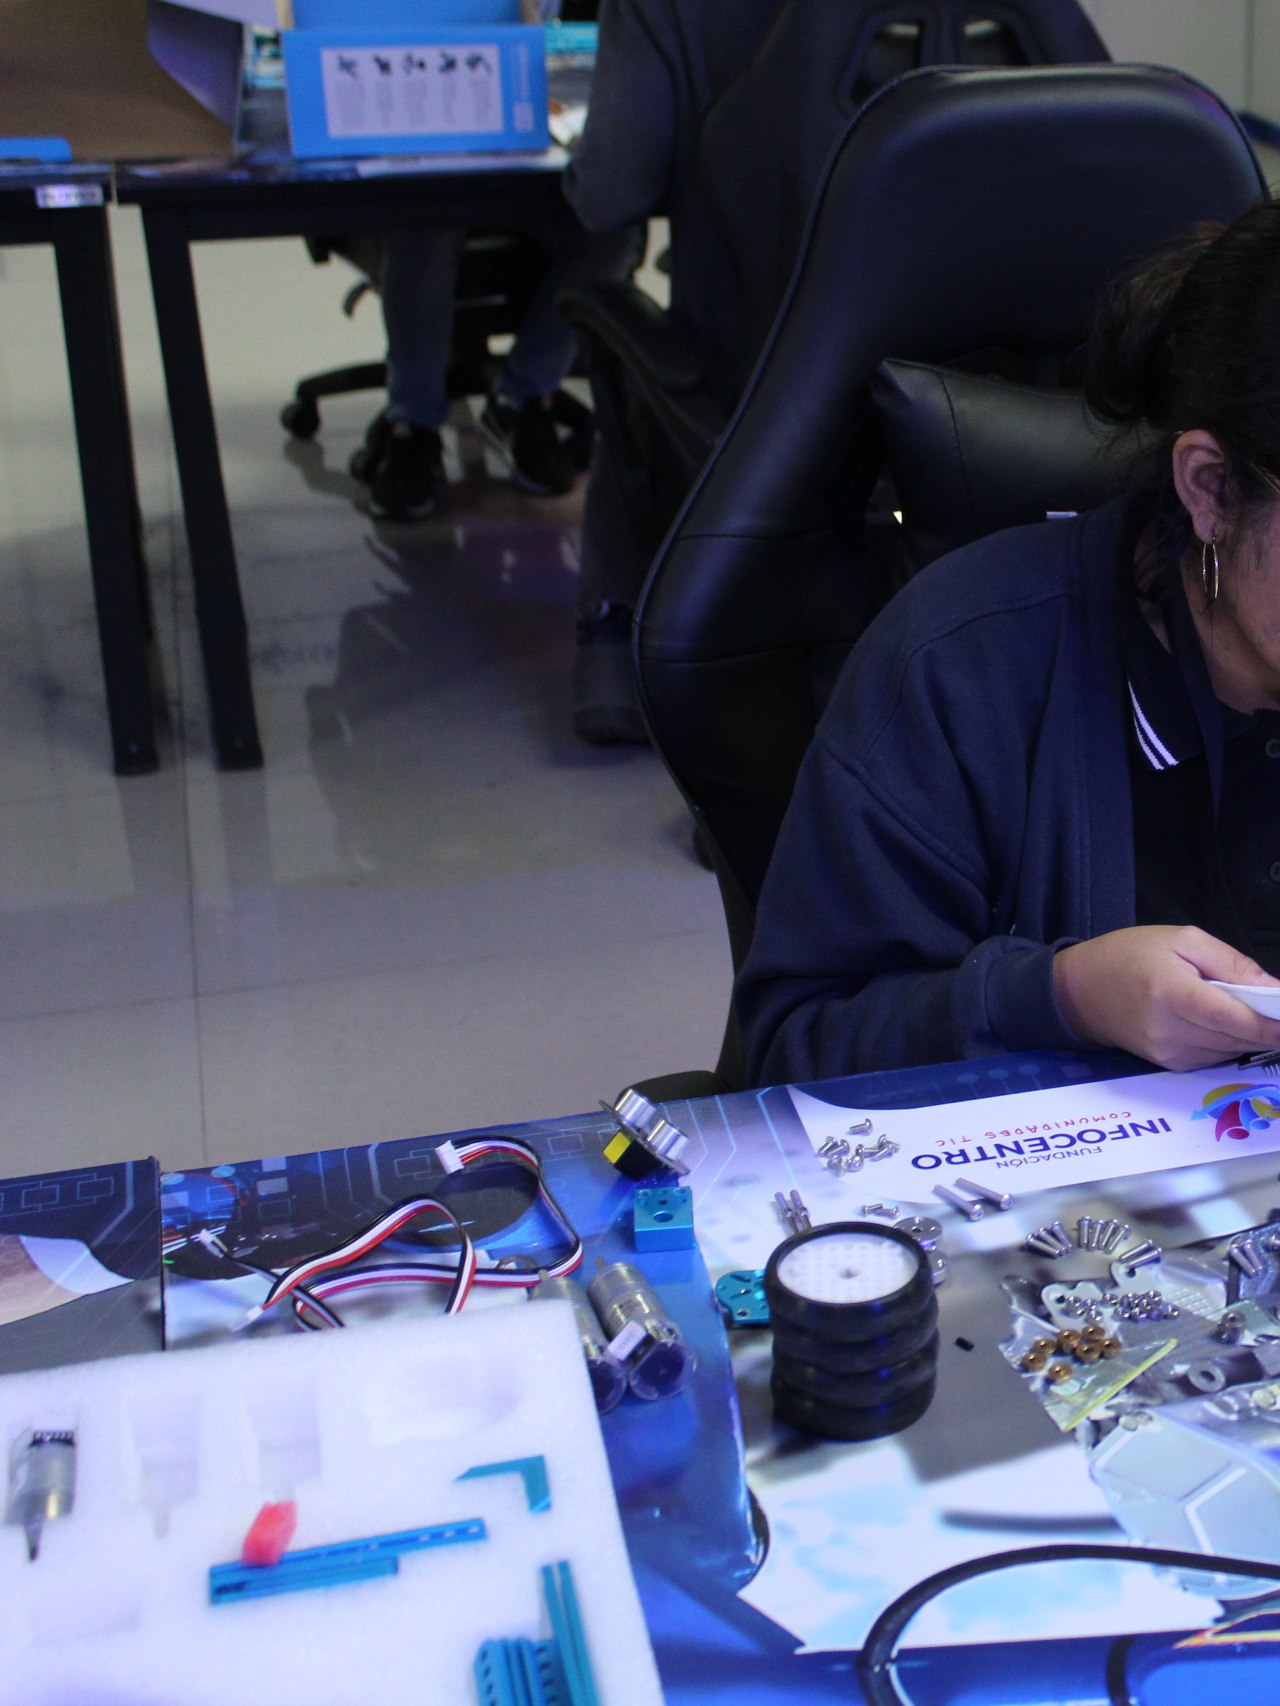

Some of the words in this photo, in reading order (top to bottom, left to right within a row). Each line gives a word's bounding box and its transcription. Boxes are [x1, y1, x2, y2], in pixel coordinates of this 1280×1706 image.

[984, 1111, 1132, 1140] COMUNIDADES
[911, 1117, 1173, 1170] INFOCENTRO
[935, 1134, 972, 1147] TIC
[996, 1145, 1104, 1169] FUNDACIÓN
